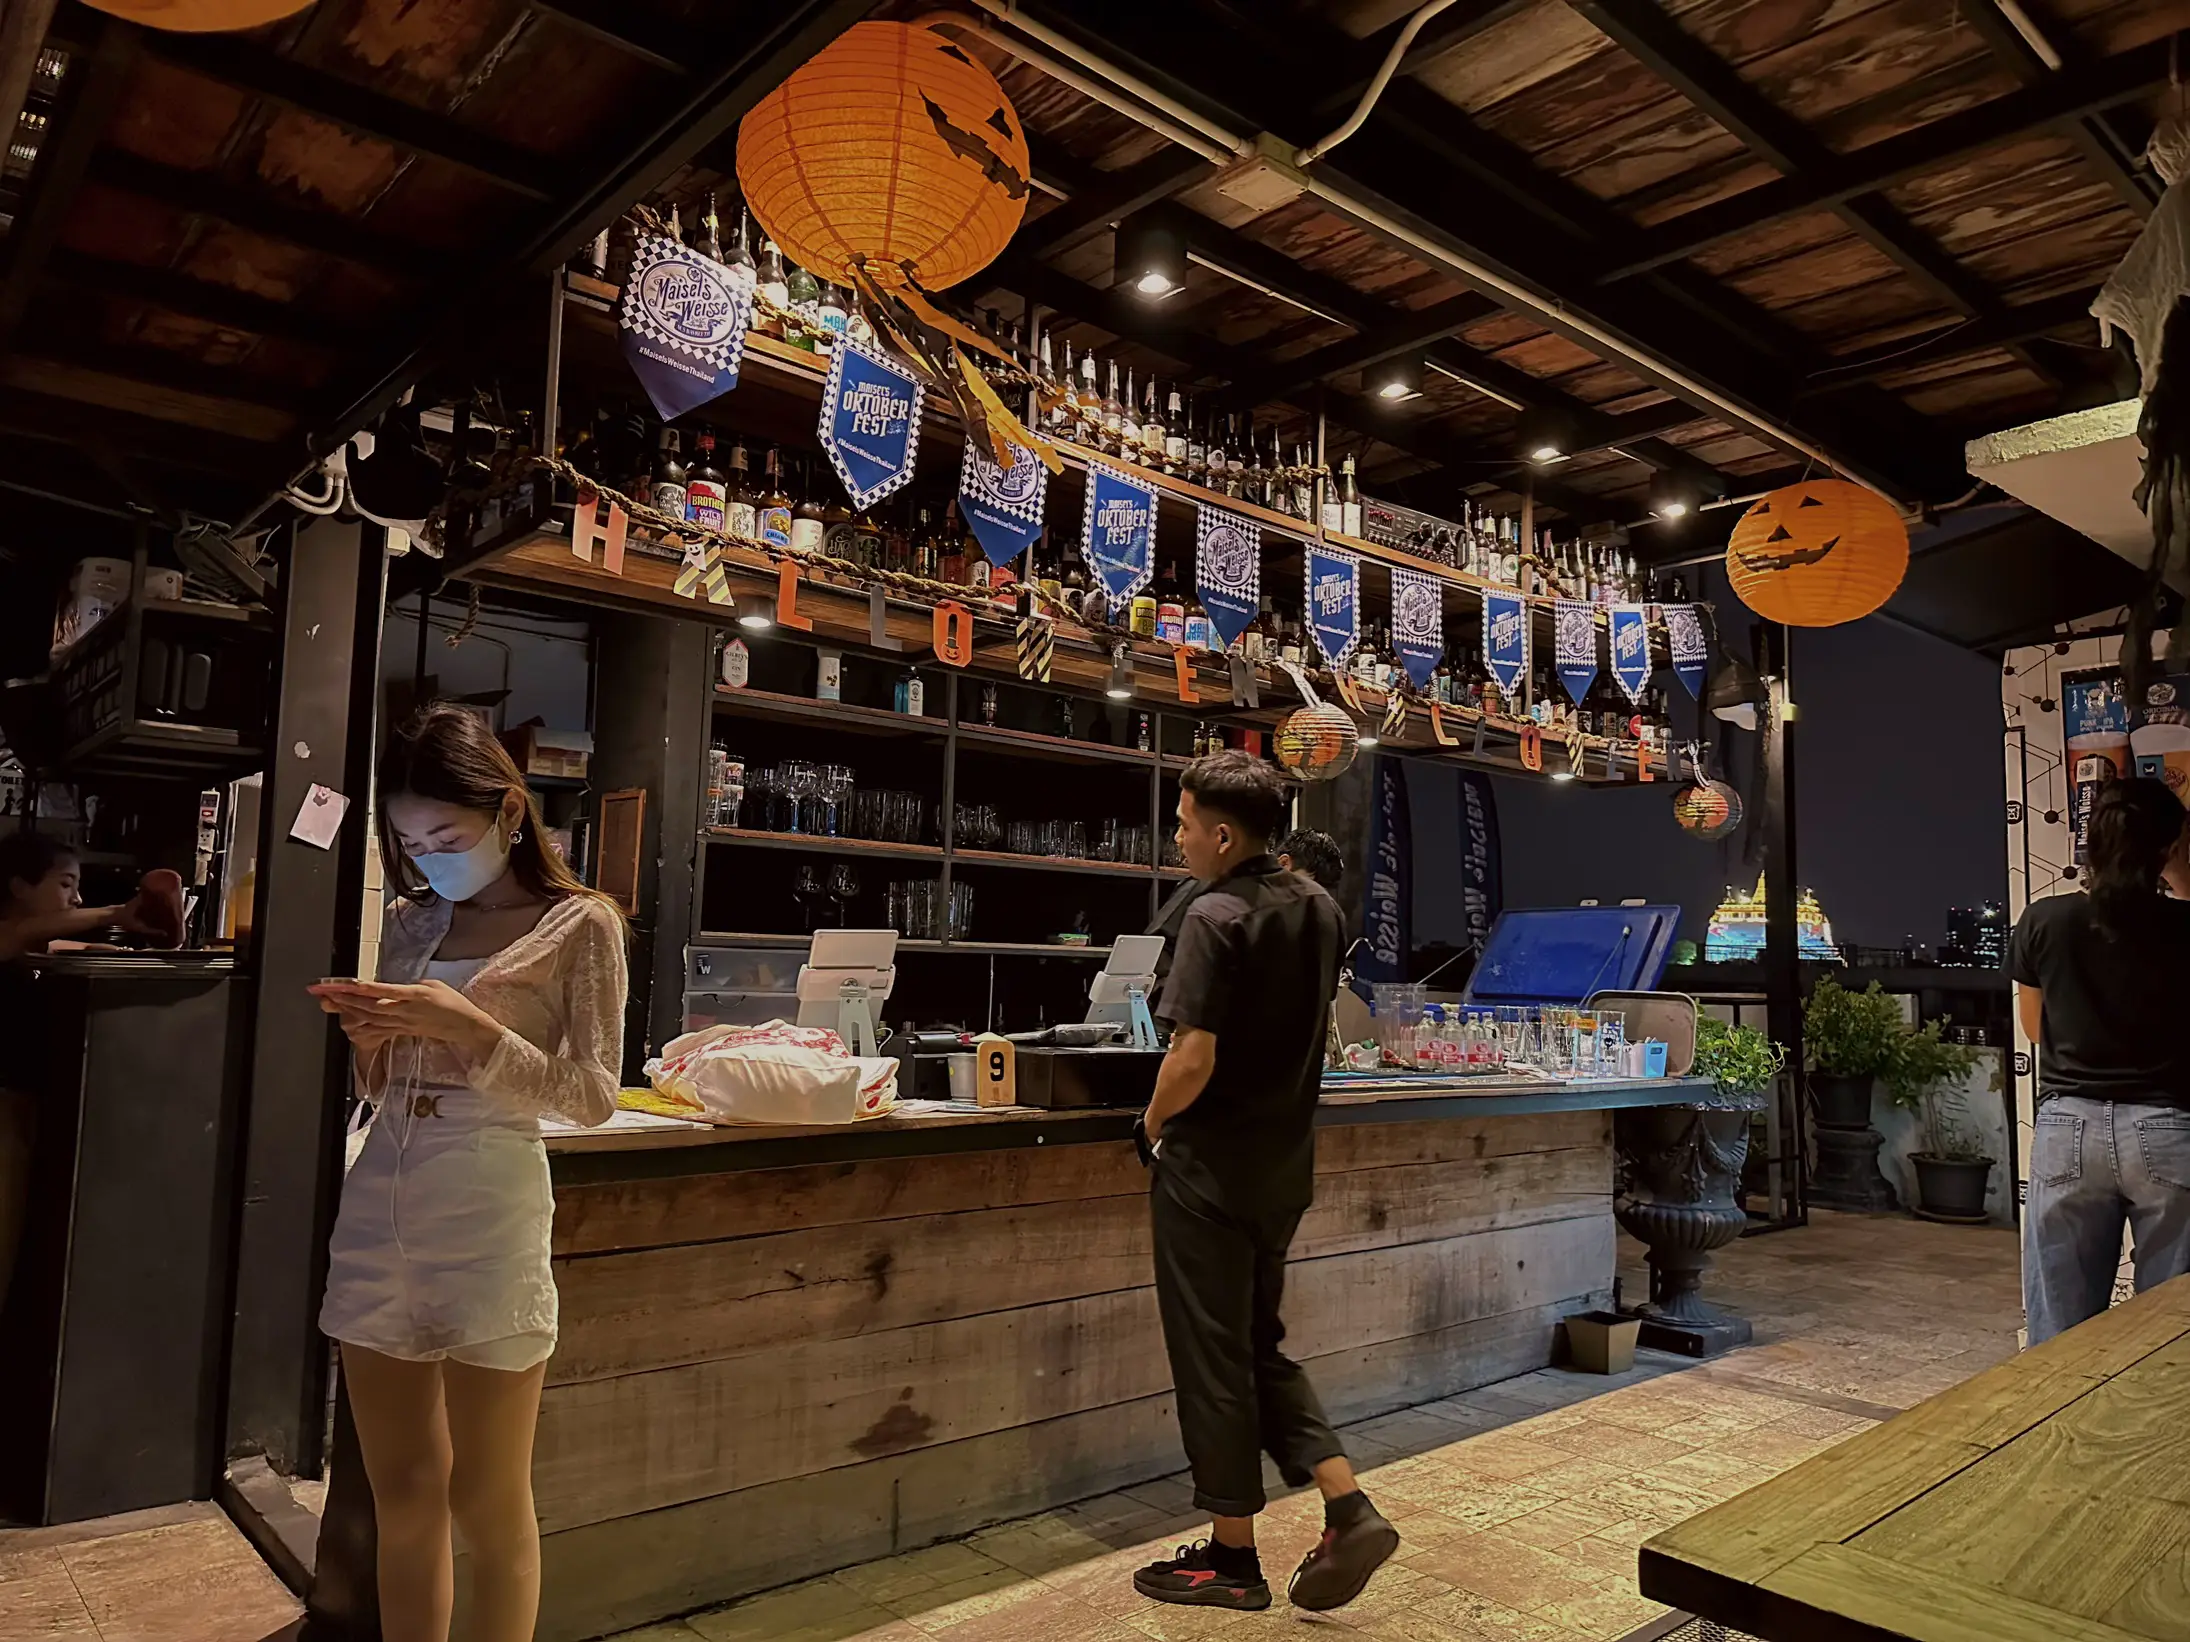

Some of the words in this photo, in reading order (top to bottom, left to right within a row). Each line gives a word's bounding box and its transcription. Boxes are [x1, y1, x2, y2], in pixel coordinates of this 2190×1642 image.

[650, 269, 712, 307] Maisel's
[678, 301, 729, 322] Weisse
[639, 346, 715, 384] #MaiselsWeisseThailand
[858, 381, 890, 396] MAISEL'S
[843, 390, 909, 420] OKTOBER
[852, 413, 891, 437] FEST
[1097, 509, 1147, 528] OKTOBER
[1105, 527, 1134, 545] FEST
[1314, 580, 1352, 602] OKTOBER
[1322, 597, 1342, 616] FEST
[1496, 632, 1513, 652] FEST
[1622, 642, 1638, 660] FEST
[989, 1051, 1004, 1082] 9
